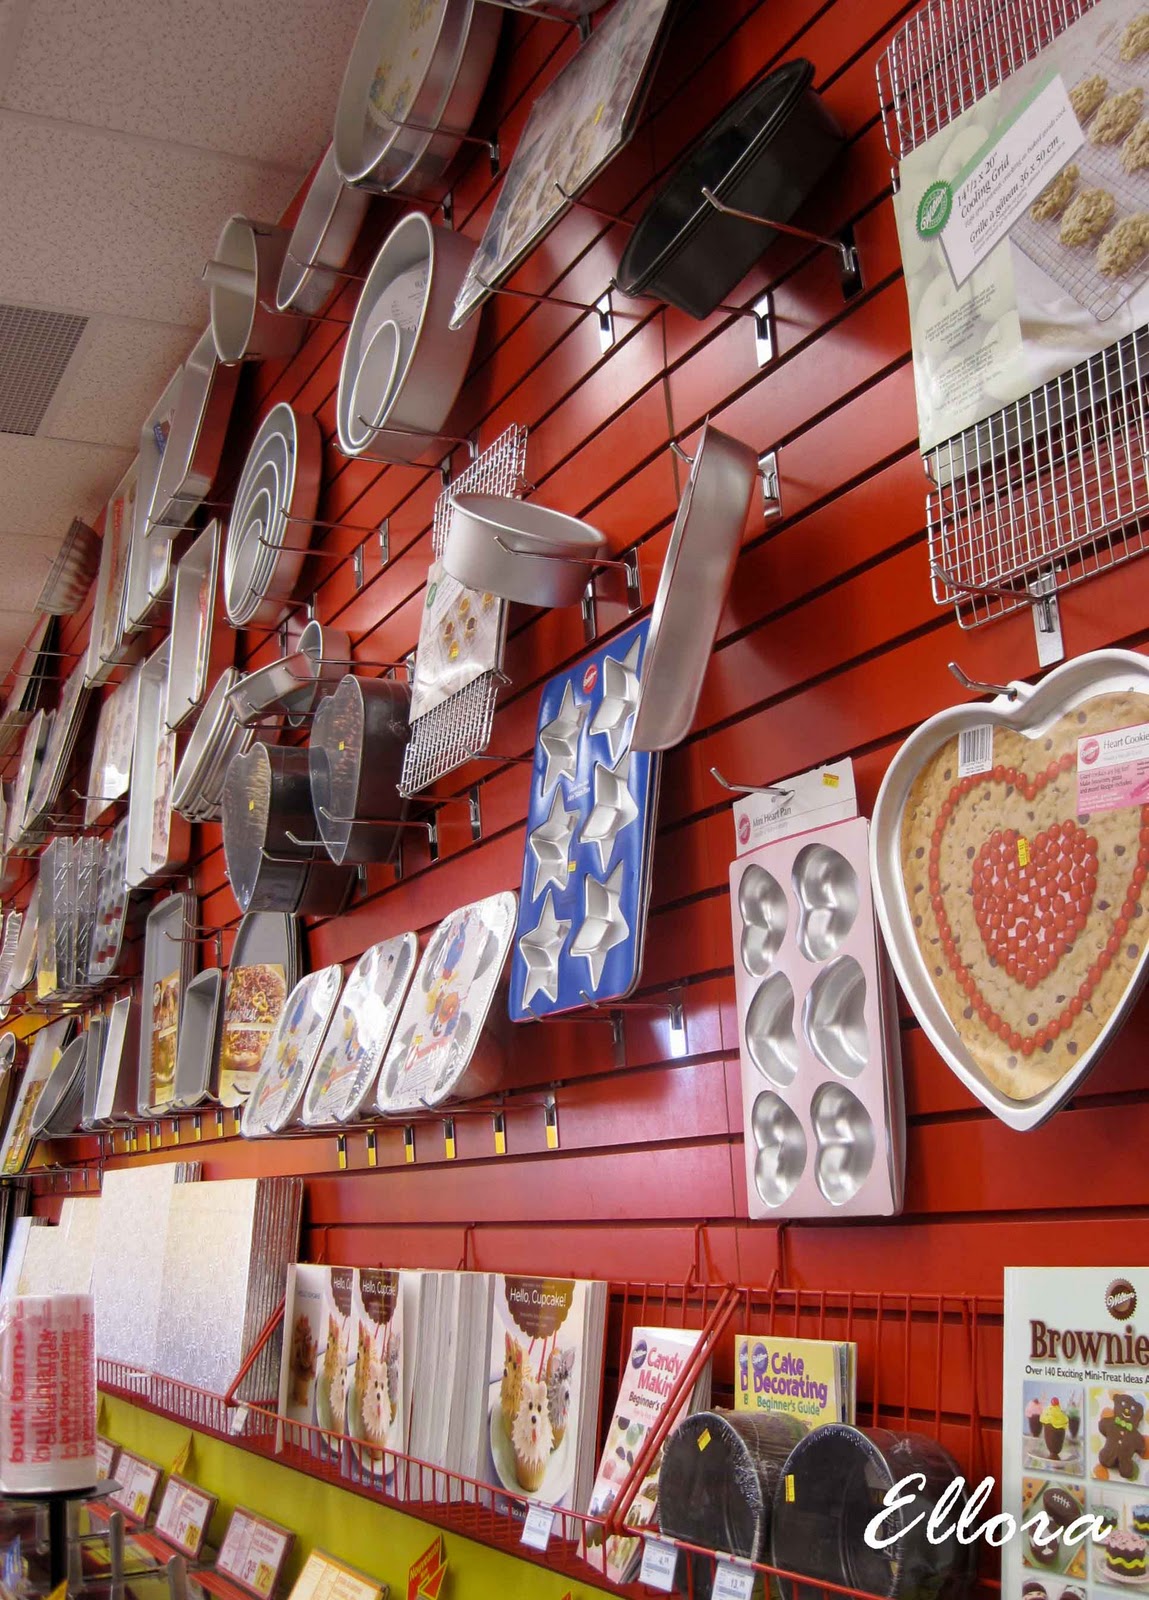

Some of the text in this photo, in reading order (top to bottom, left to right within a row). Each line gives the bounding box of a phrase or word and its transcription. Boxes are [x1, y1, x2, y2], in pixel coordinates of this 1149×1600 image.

[961, 180, 991, 219] Cooling
[991, 153, 1010, 182] Grid
[969, 217, 988, 243] Grille
[995, 183, 1019, 216] gâteau
[1019, 171, 1030, 189] 36
[1035, 149, 1046, 163] 50
[1046, 135, 1060, 153] cm
[1103, 737, 1123, 750] Heart
[764, 809, 779, 822] Heart
[780, 807, 791, 817] Pan
[362, 1280, 376, 1295] Hello,
[510, 1287, 567, 1307] Hello, Cupcake!
[1029, 1319, 1149, 1366] Brownie
[647, 1346, 684, 1380] Candy
[771, 1352, 805, 1376] Cake
[1025, 1365, 1042, 1376] Over
[1045, 1367, 1055, 1376] 140
[1057, 1368, 1083, 1381] Exciting
[1085, 1370, 1122, 1382] Mini-Treat
[1123, 1373, 1143, 1384] Ideas
[637, 1369, 676, 1398] Makin
[753, 1370, 828, 1409] Decorating
[9, 1344, 24, 1464] bulk barn
[629, 1391, 659, 1410] Beginner's
[757, 1395, 796, 1413] Beginner's
[797, 1401, 820, 1416] Guide
